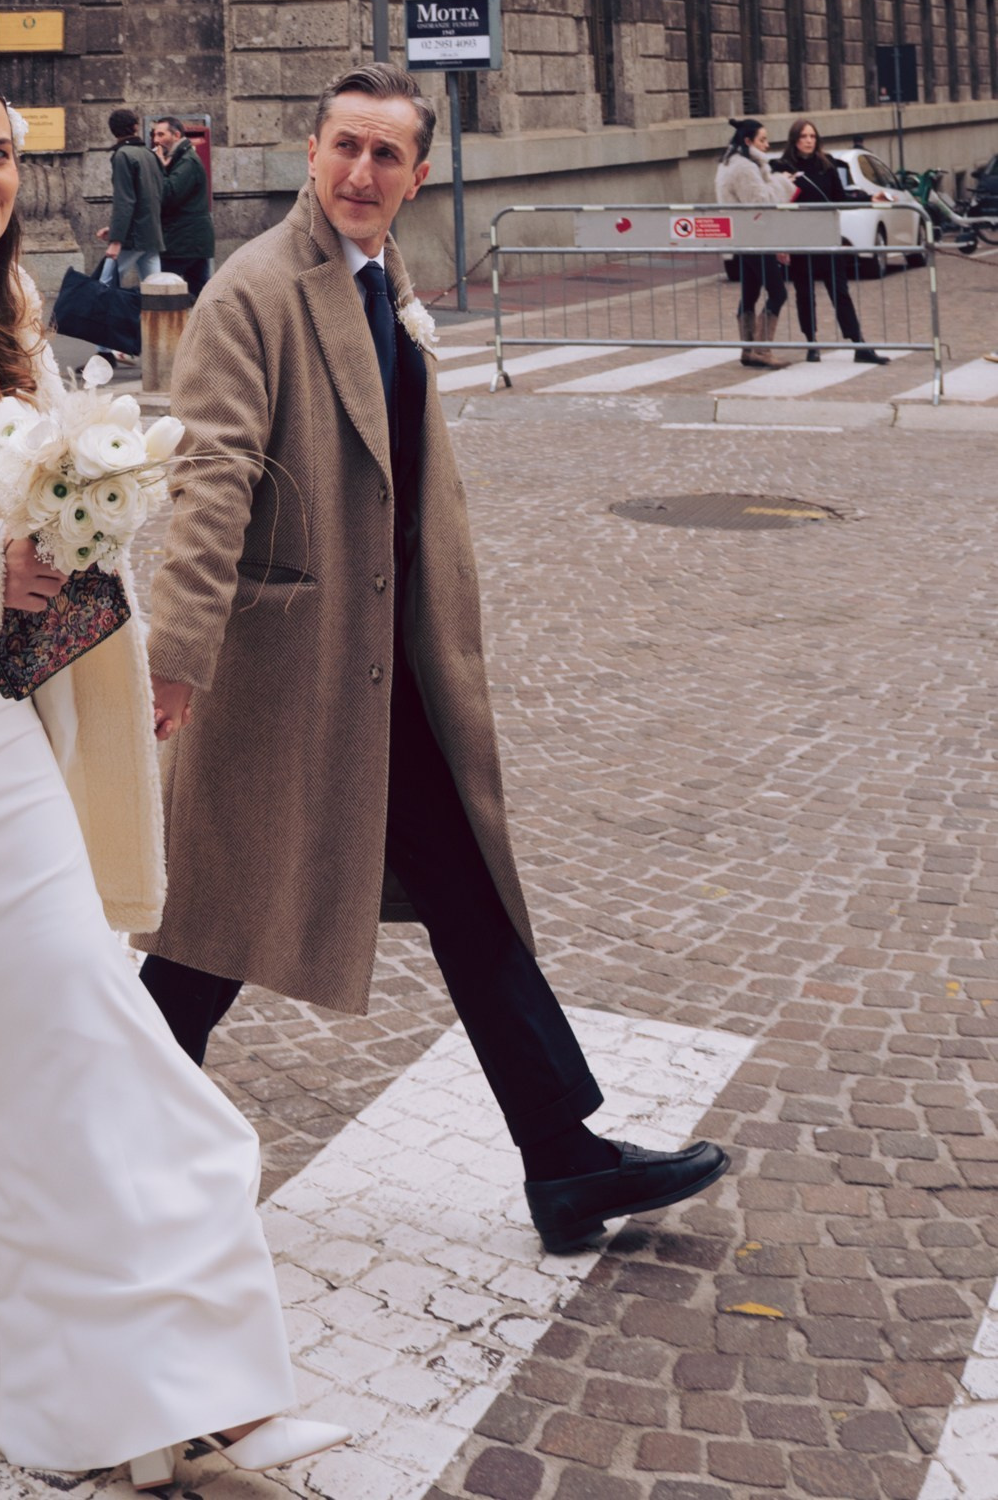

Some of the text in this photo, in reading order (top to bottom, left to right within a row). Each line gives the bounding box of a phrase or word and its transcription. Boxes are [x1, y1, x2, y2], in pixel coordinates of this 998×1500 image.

[416, 3, 480, 23] MOTTA
[421, 41, 432, 49] 02
[455, 39, 477, 48] 4093
